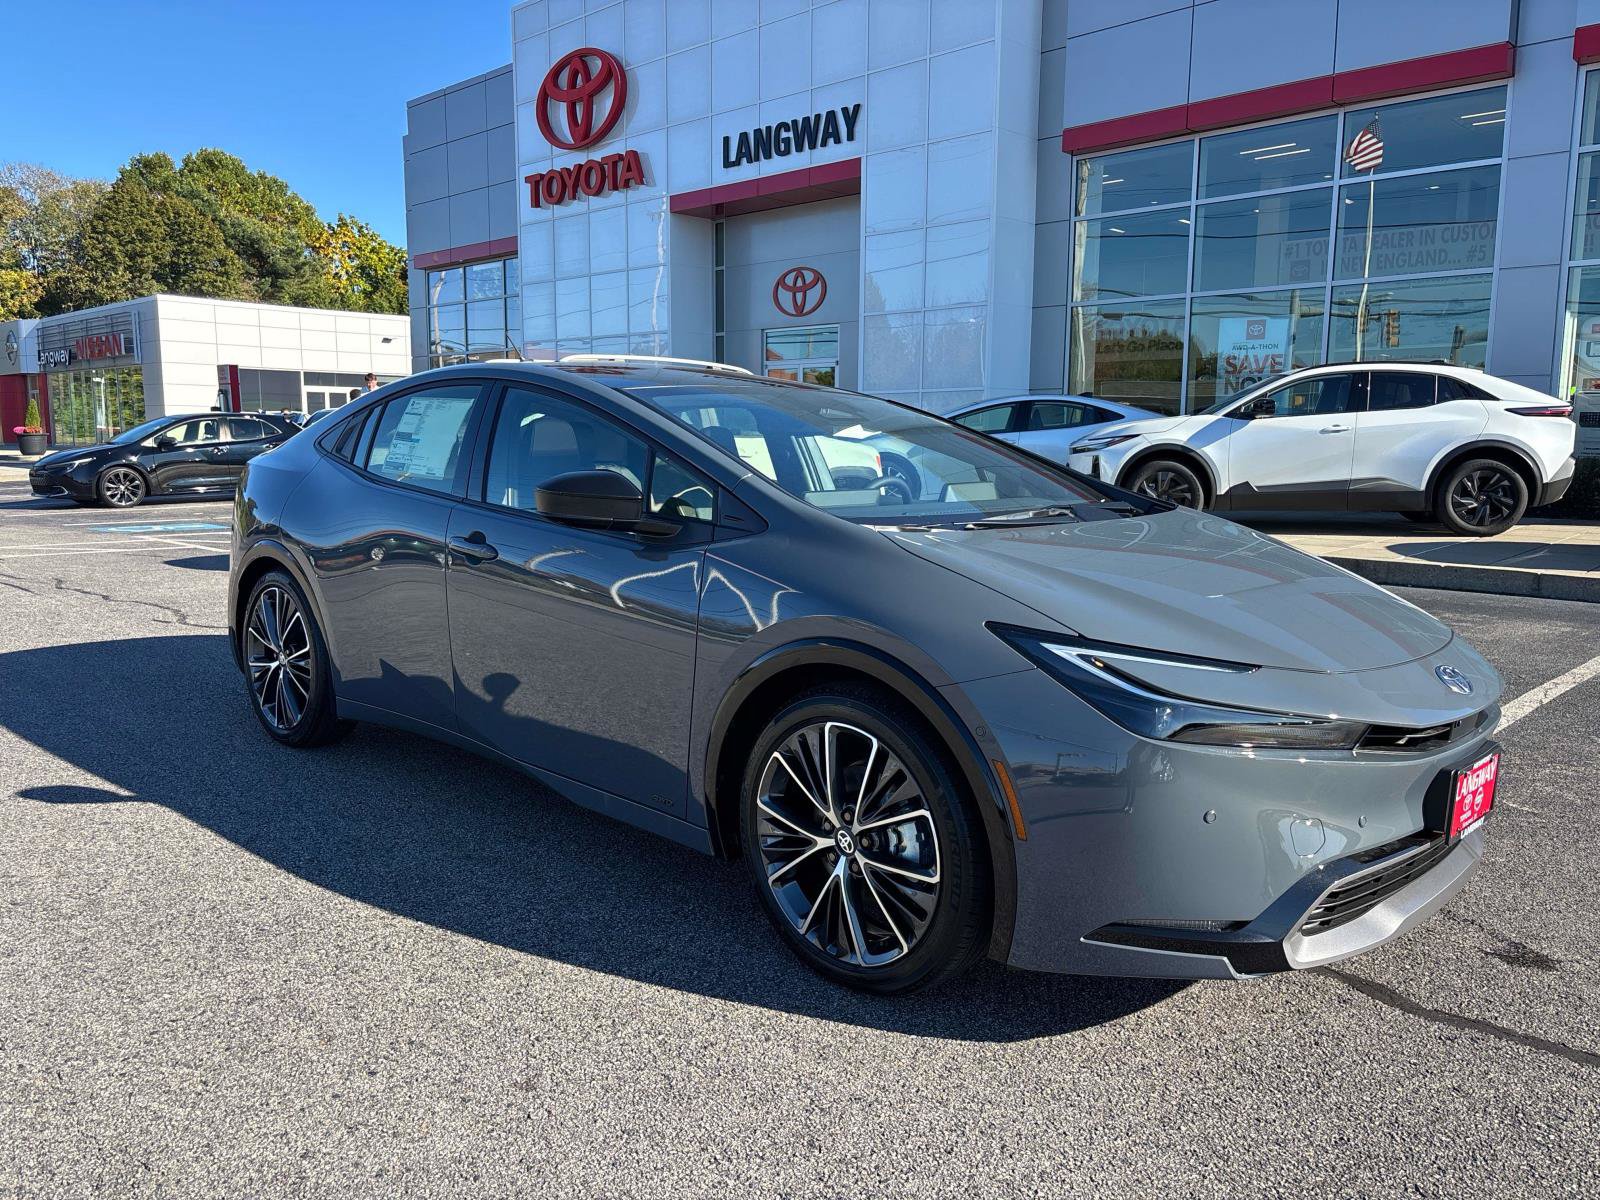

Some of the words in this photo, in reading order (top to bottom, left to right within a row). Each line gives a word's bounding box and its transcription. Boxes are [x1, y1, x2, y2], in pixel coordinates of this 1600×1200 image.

[723, 103, 861, 169] LANGWAY
[525, 150, 645, 208] TOYOTA
[1305, 236, 1357, 258] TOYTA
[1420, 228, 1436, 246] IN
[1376, 249, 1460, 270] ENGLAND...
[1465, 244, 1487, 262] #5
[75, 332, 125, 360] NISSAN
[1096, 341, 1125, 354] Let's
[1127, 341, 1146, 352] Go
[1231, 343, 1279, 351] AWD-A-THON
[1224, 353, 1284, 375] SAVE
[1224, 376, 1263, 395] NO
[1456, 760, 1496, 801] LANGWAY
